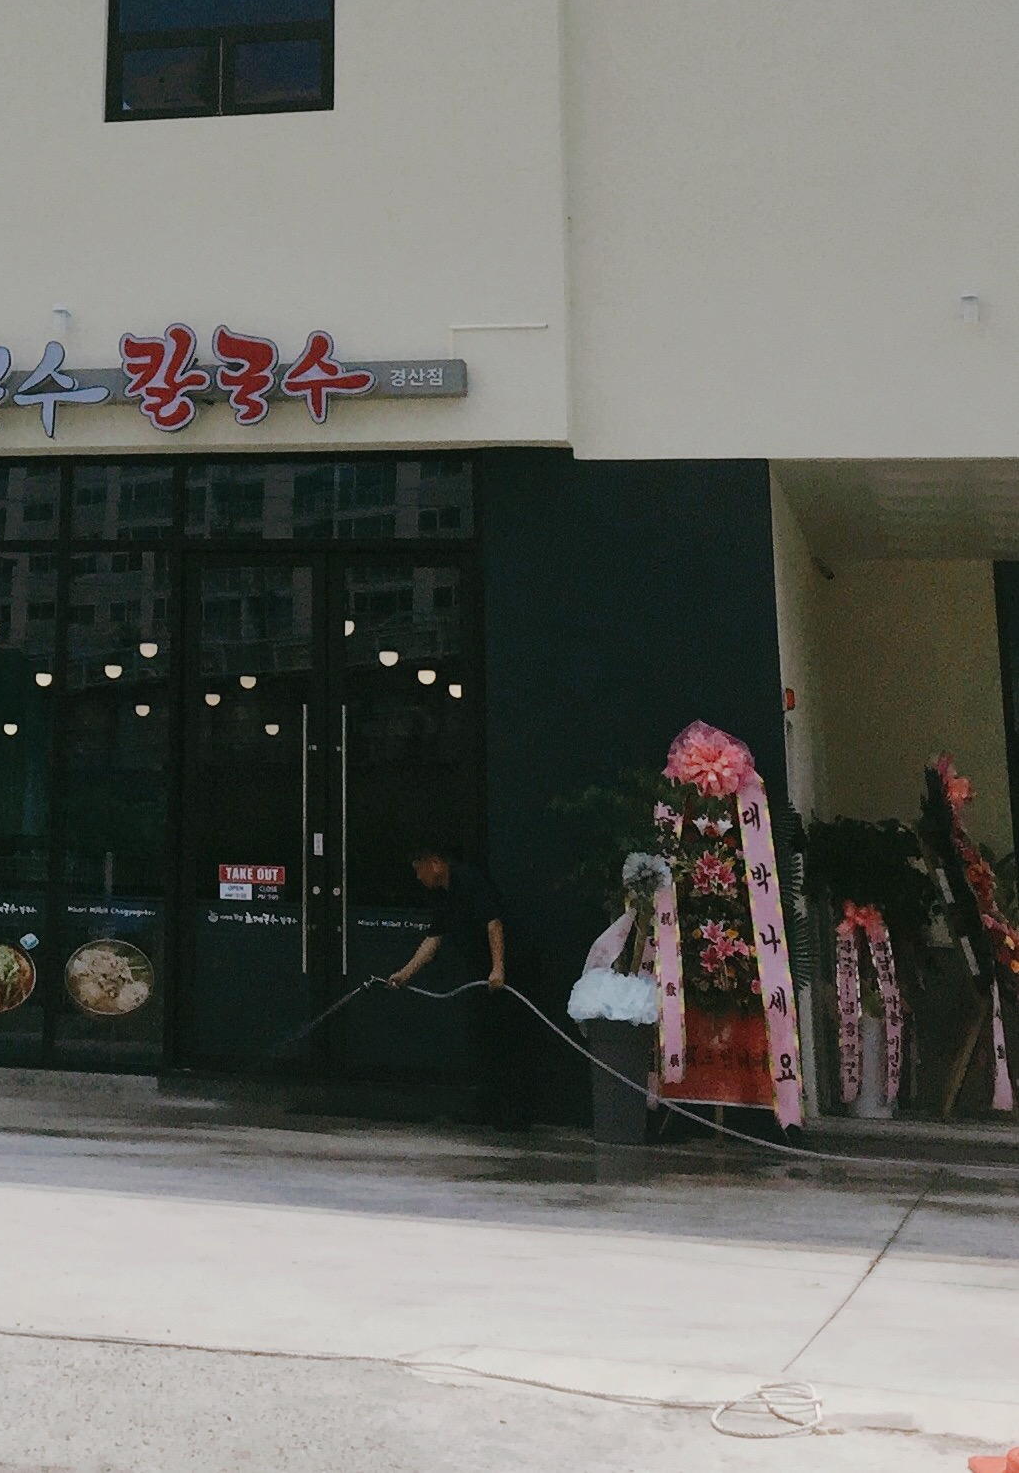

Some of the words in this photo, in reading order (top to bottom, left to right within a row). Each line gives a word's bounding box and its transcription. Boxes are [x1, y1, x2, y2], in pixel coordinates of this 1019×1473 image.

[120, 323, 376, 432] 칼국수
[390, 367, 443, 387] 경산점
[225, 867, 253, 880] TAKE
[256, 868, 279, 881] OUT
